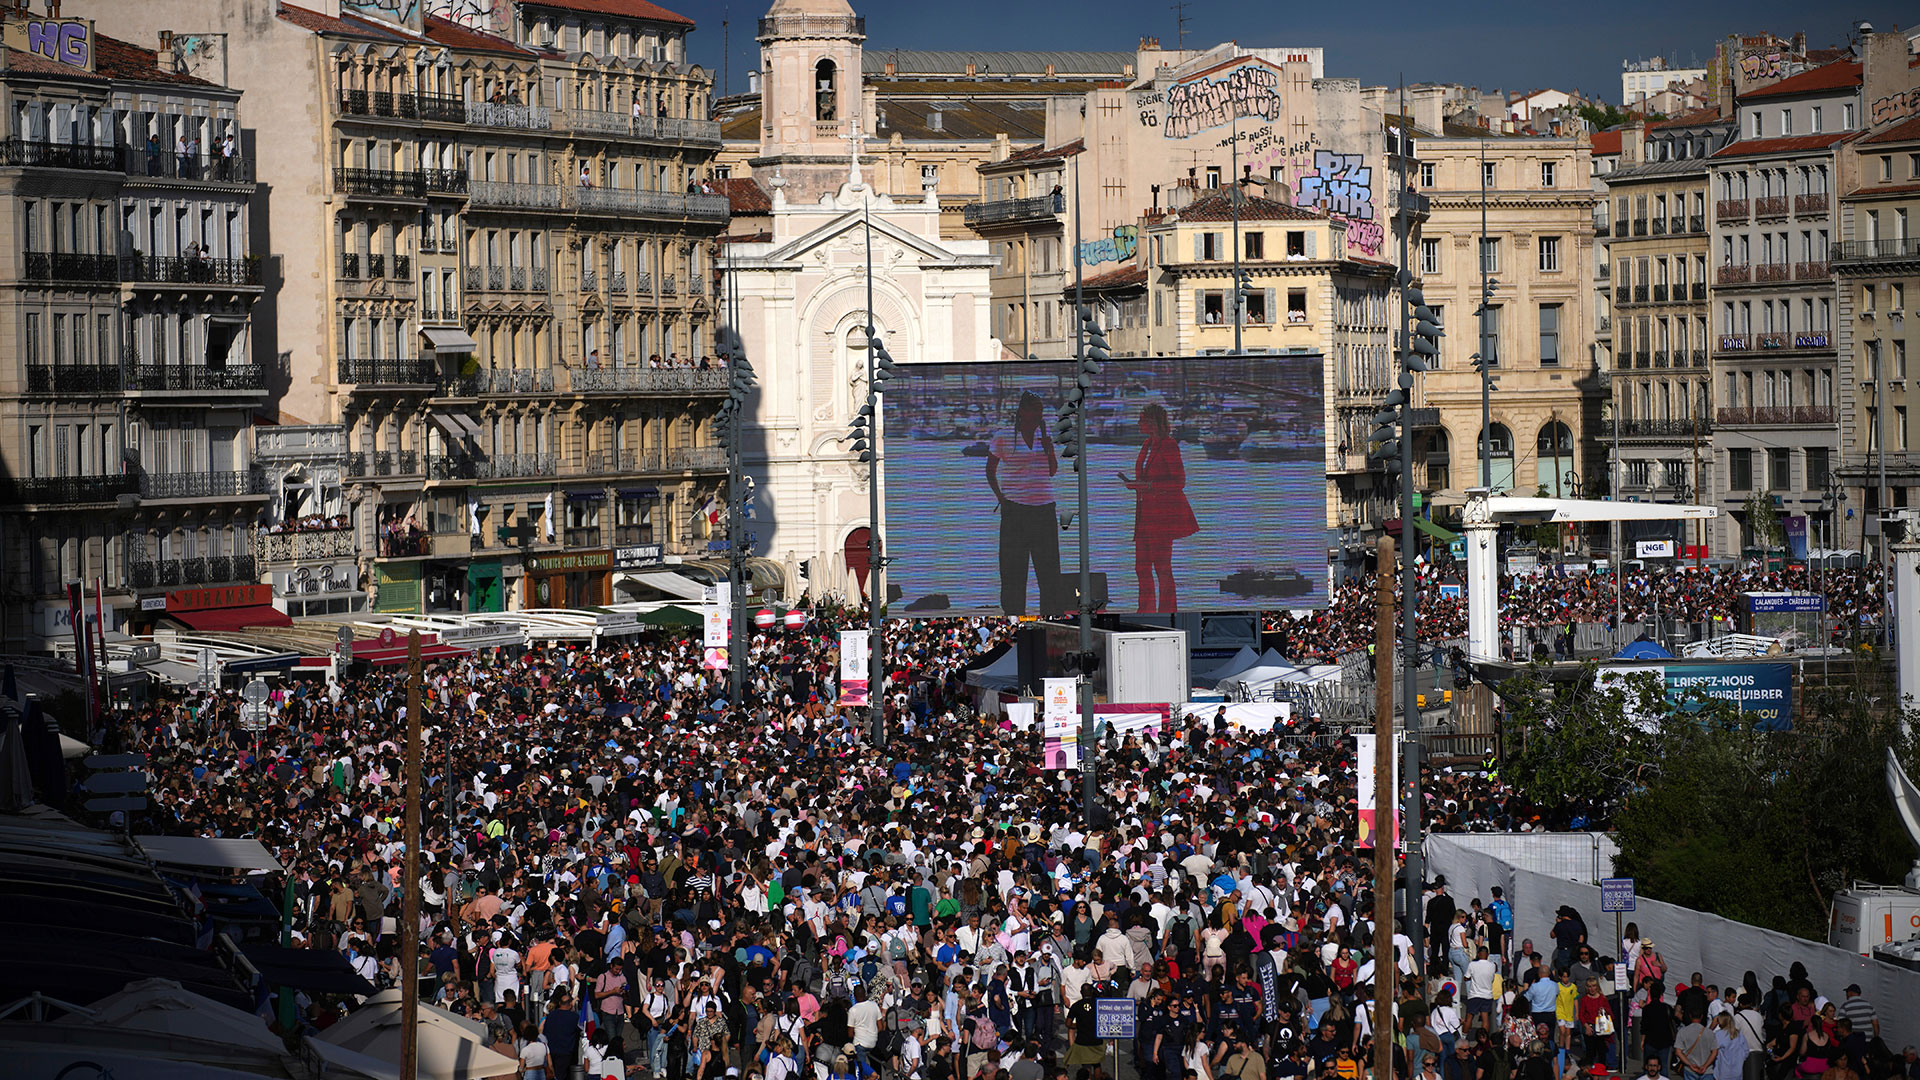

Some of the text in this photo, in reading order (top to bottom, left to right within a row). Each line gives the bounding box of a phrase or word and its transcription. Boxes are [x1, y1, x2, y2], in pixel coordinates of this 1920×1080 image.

[28, 21, 88, 68] HG
[1646, 543, 1665, 551] NGE
[183, 587, 256, 608] MIRAMAR
[1755, 598, 1784, 606] CALANQUES
[1674, 675, 1755, 688] LAISSEZ-NOUS
[1742, 689, 1783, 700] VIBRER
[1099, 1014, 1109, 1022] 60
[1110, 1014, 1120, 1022] 82
